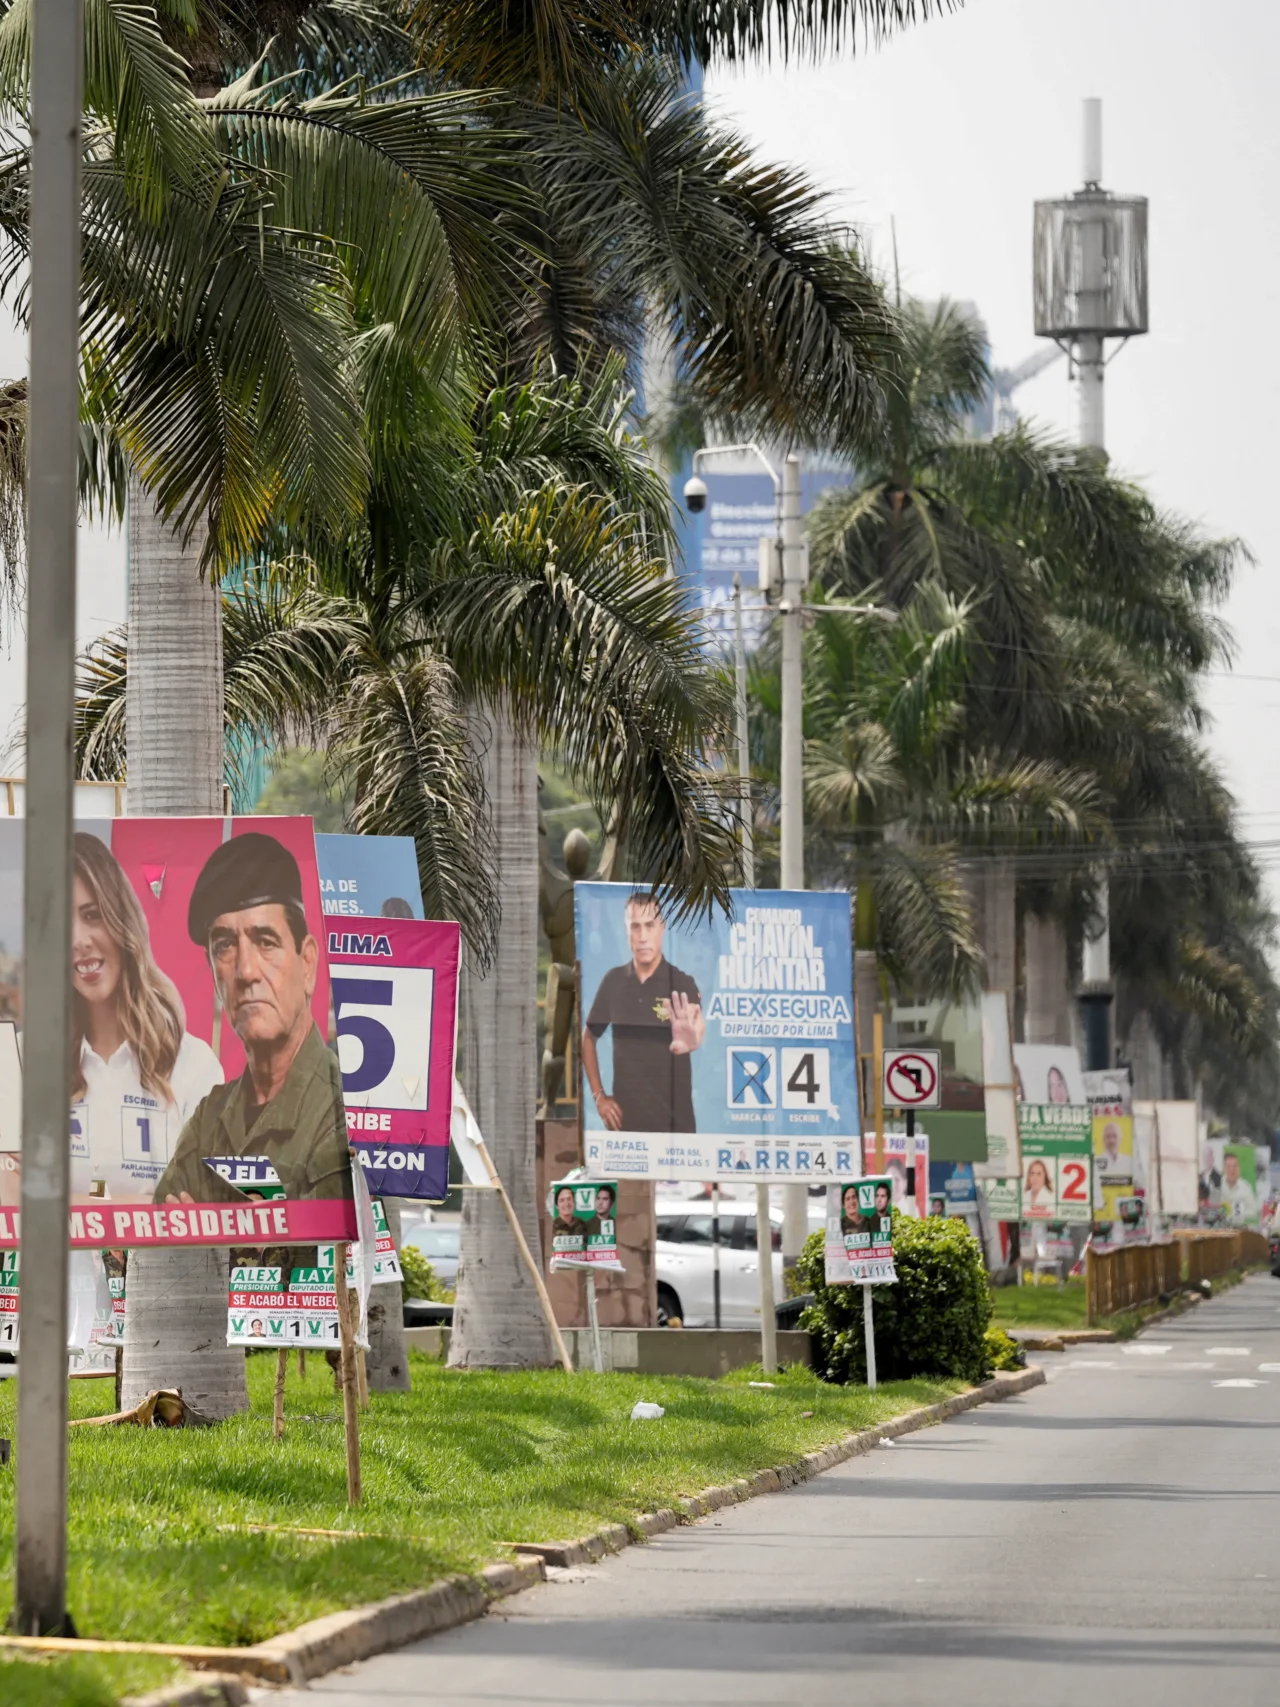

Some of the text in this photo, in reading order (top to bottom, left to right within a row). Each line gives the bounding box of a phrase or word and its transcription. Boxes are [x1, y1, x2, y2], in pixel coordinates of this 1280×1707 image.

[338, 879, 358, 893] DE
[322, 899, 365, 915] MES.
[328, 932, 393, 957] LIMA
[710, 996, 848, 1020] ALEX SEGURA
[330, 977, 396, 1093] 5
[724, 1023, 834, 1037] DIPUTADO POR LIMA
[732, 1050, 820, 1105] R 4
[789, 1113, 820, 1123] ESCRIBE
[1043, 1105, 1091, 1125] VERDE
[136, 1117, 151, 1153] 1
[589, 1145, 600, 1159] R
[606, 1140, 649, 1152] RAFAEL
[665, 1147, 685, 1156] VOTA
[657, 1158, 685, 1167] MARCA
[687, 1158, 703, 1167] LAS
[718, 1149, 851, 1170] R R R R 4 R
[131, 1171, 158, 1180] ANDINO
[1061, 1162, 1088, 1201] 2
[372, 1203, 380, 1218] 1
[113, 1207, 290, 1238] PRESIDENTE
[556, 1235, 611, 1245] ALEX LAY
[847, 1234, 869, 1244] ALEX
[7, 1251, 18, 1270] 1
[323, 1247, 334, 1266] 1
[387, 1260, 397, 1273] 1
[234, 1269, 278, 1282] ALEX
[298, 1269, 334, 1283] LAY
[290, 1284, 326, 1292] DIPUTADO
[233, 1294, 247, 1306] SE
[249, 1291, 285, 1307] ACABÓ
[287, 1295, 300, 1307] EL
[3, 1324, 14, 1341] 1
[231, 1318, 339, 1339] V V 1 V 1
